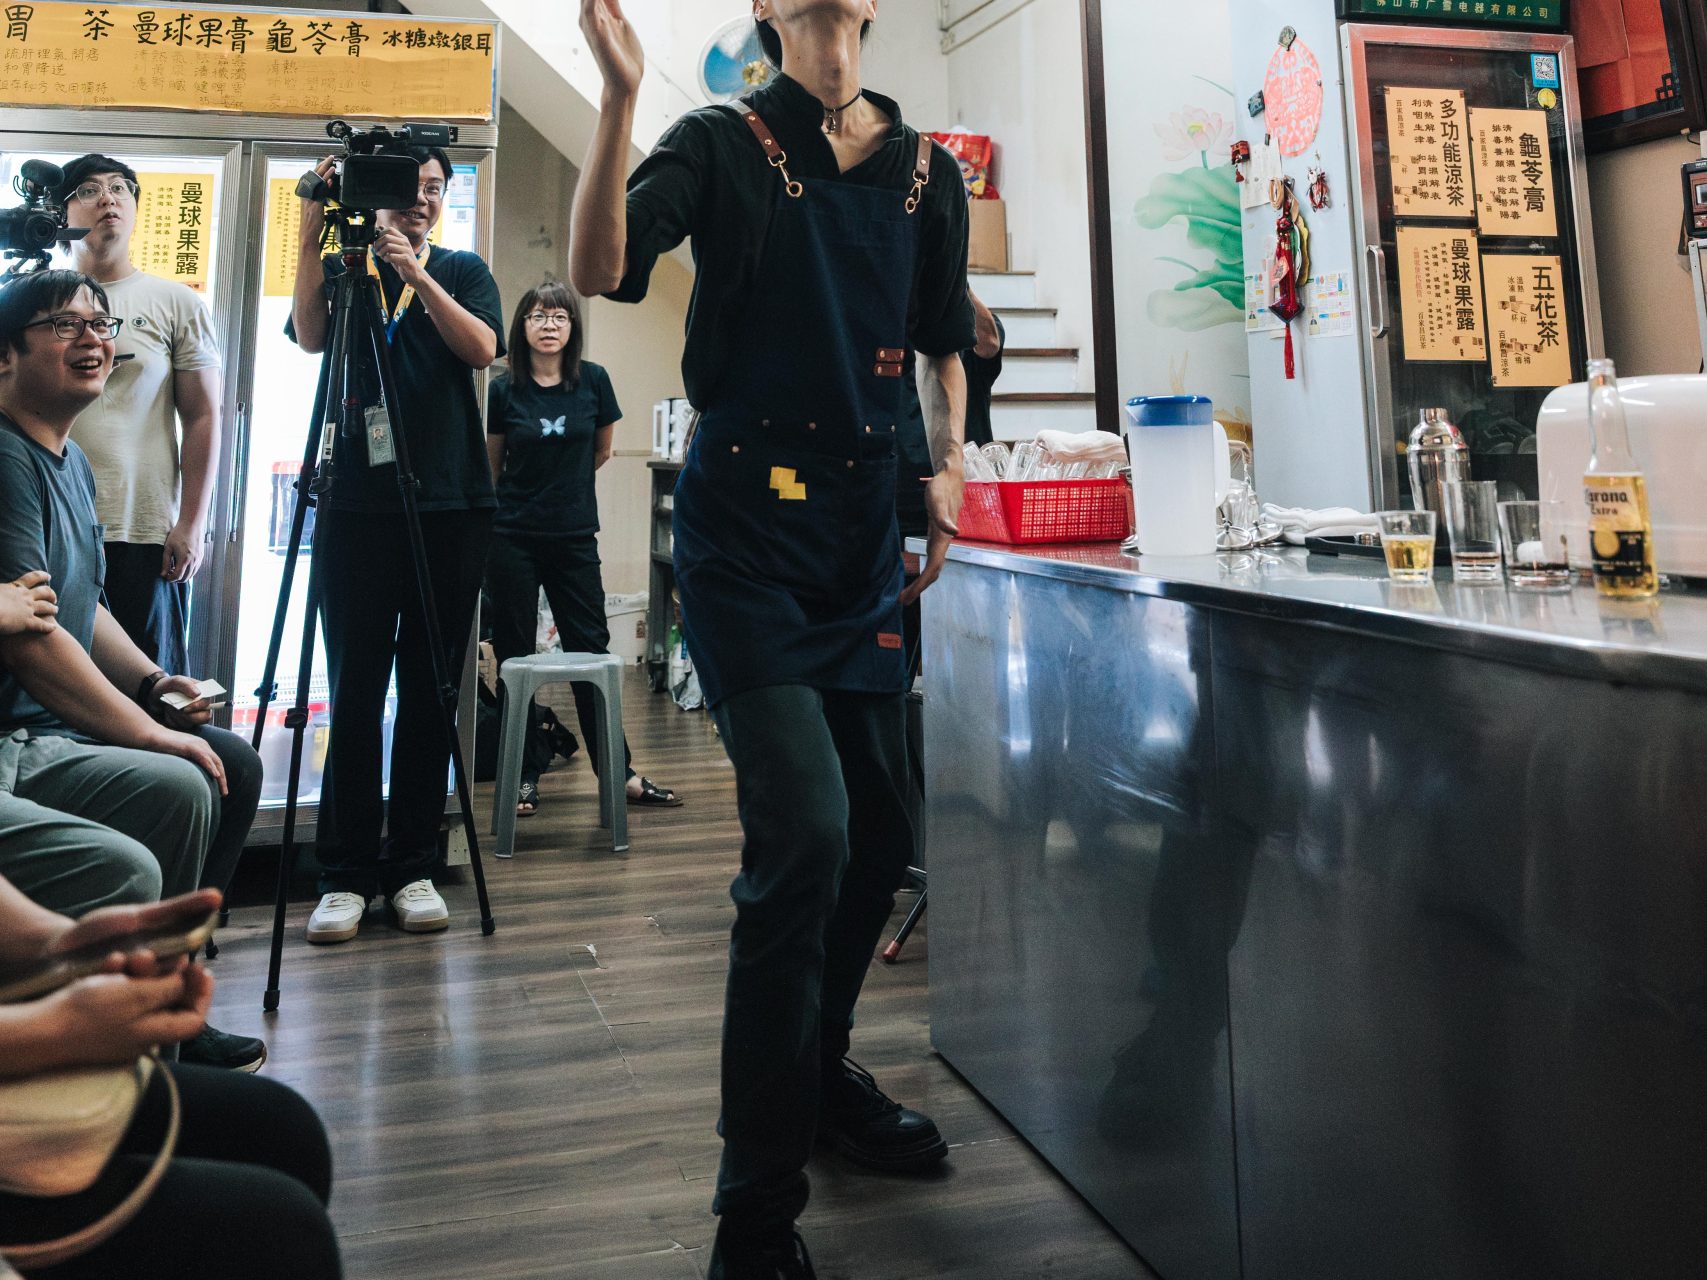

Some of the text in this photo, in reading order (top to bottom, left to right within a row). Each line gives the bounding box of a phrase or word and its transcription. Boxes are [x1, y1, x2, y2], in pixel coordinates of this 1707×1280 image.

[83, 9, 114, 40] 茶
[133, 11, 254, 53] 曼球果膏
[266, 19, 369, 57] 龜苓膏
[382, 28, 492, 56] 冰糖燉銀耳
[1423, 100, 1436, 144] 清熱解毒
[1440, 99, 1464, 206] 多功能涼茶
[1519, 133, 1545, 212] 龜苓膏
[175, 182, 203, 275] 曼球果露
[1451, 239, 1475, 330] 曼球果露
[1532, 267, 1559, 346] 五花茶
